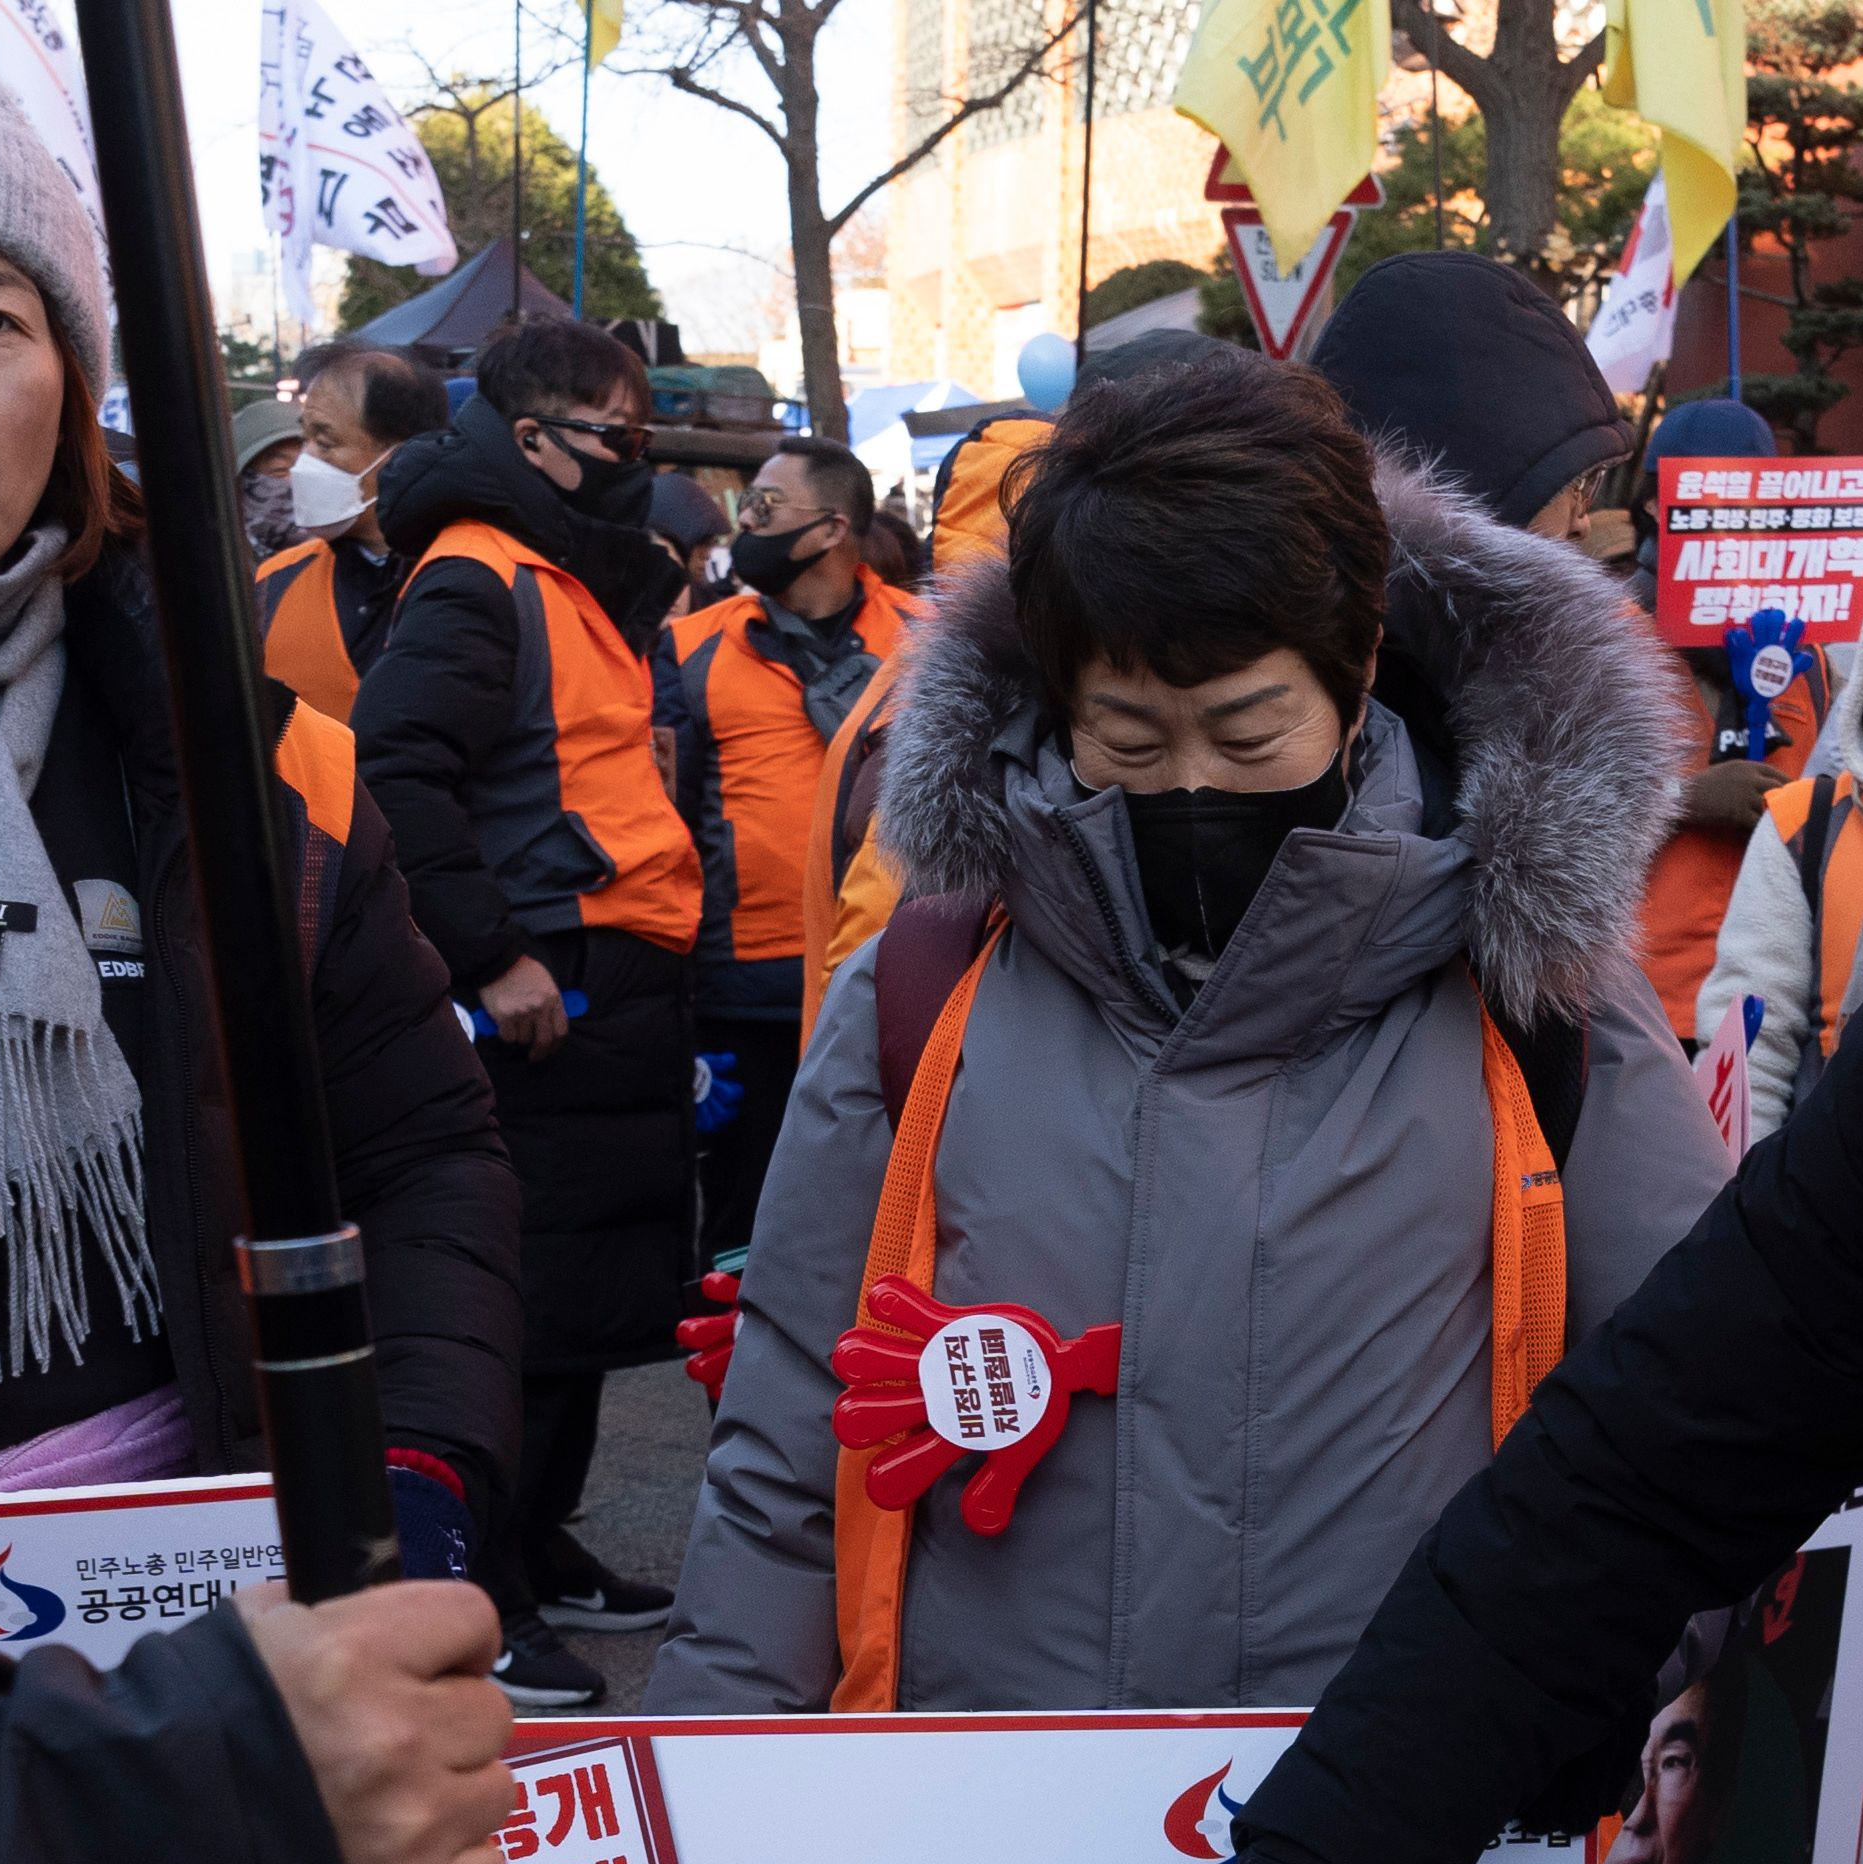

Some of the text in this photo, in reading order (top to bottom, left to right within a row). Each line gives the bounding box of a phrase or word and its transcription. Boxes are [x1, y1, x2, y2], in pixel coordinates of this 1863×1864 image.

[1676, 470, 1753, 500] 윤석열
[943, 1335, 986, 1438] 비정규직
[978, 1328, 1021, 1433] 차별철폐
[76, 1552, 168, 1582] 민주노총
